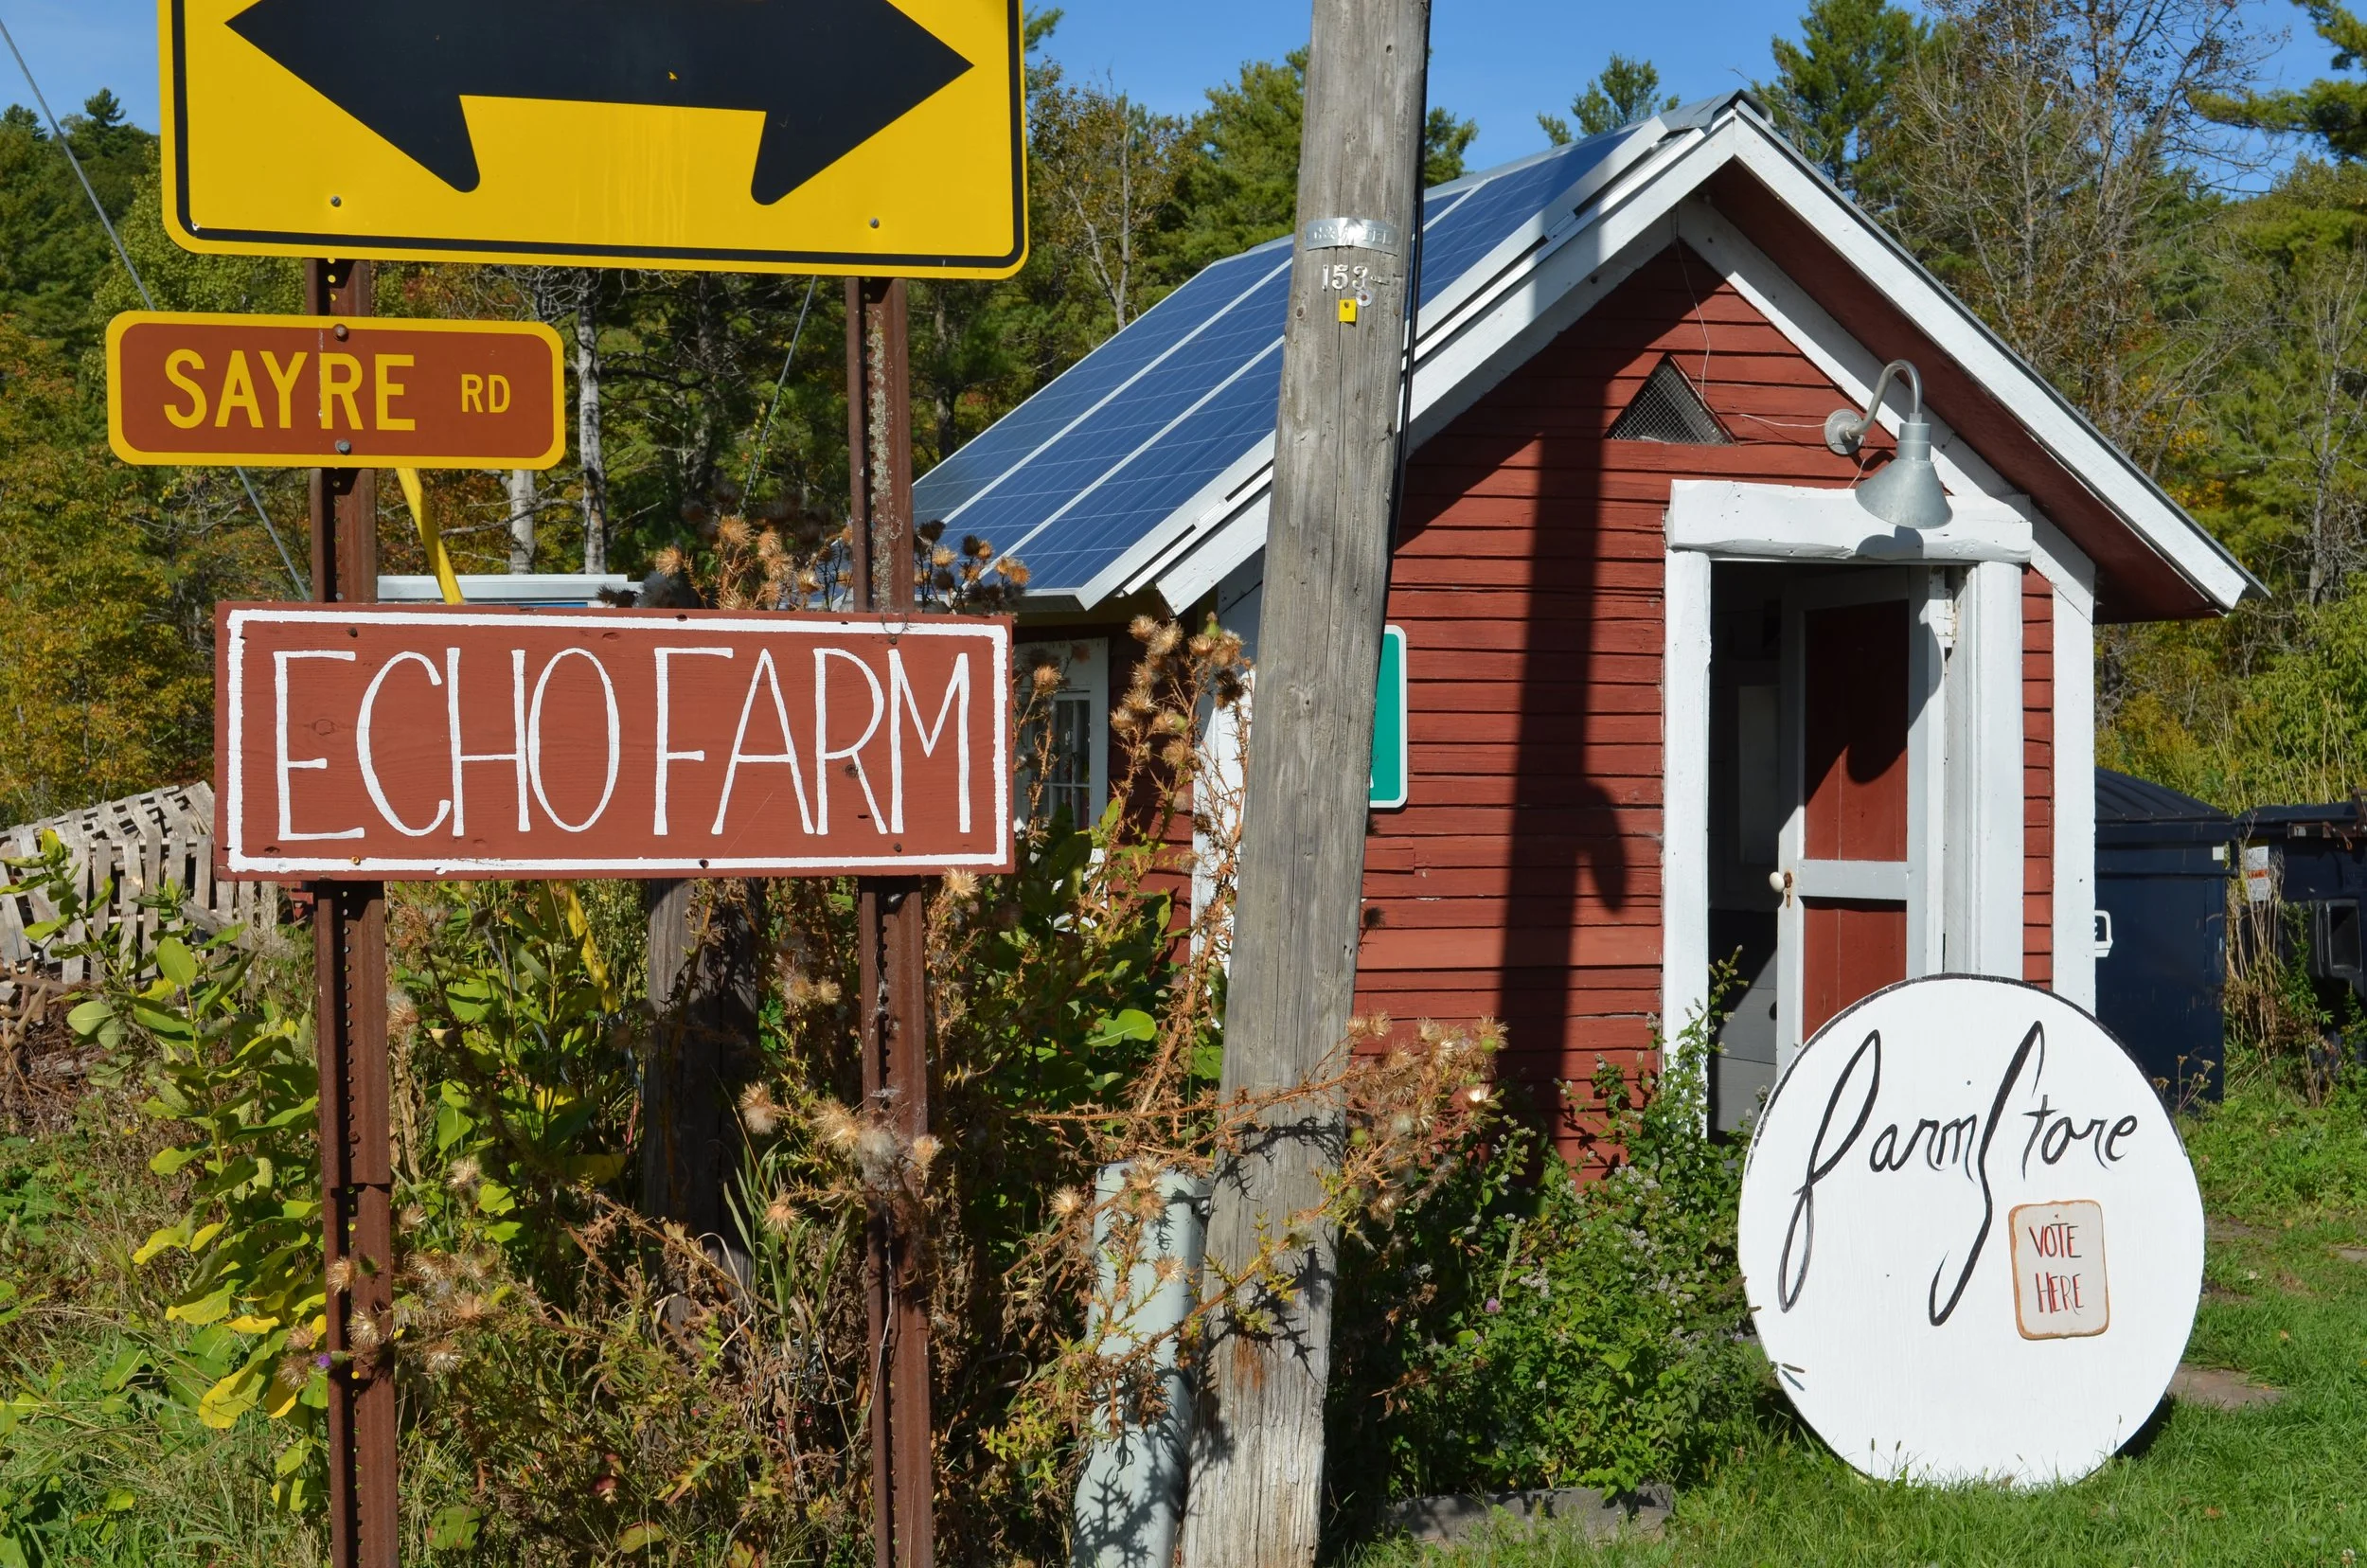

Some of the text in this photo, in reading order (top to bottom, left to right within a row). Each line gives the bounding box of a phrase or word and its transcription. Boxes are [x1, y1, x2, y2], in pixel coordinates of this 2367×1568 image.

[164, 348, 510, 431] SAYRE RD
[273, 647, 971, 841] ECHO FARM
[1929, 1021, 2138, 1327] Store
[2028, 1222, 2082, 1258] VOTE
[2035, 1272, 2084, 1315] HERE
